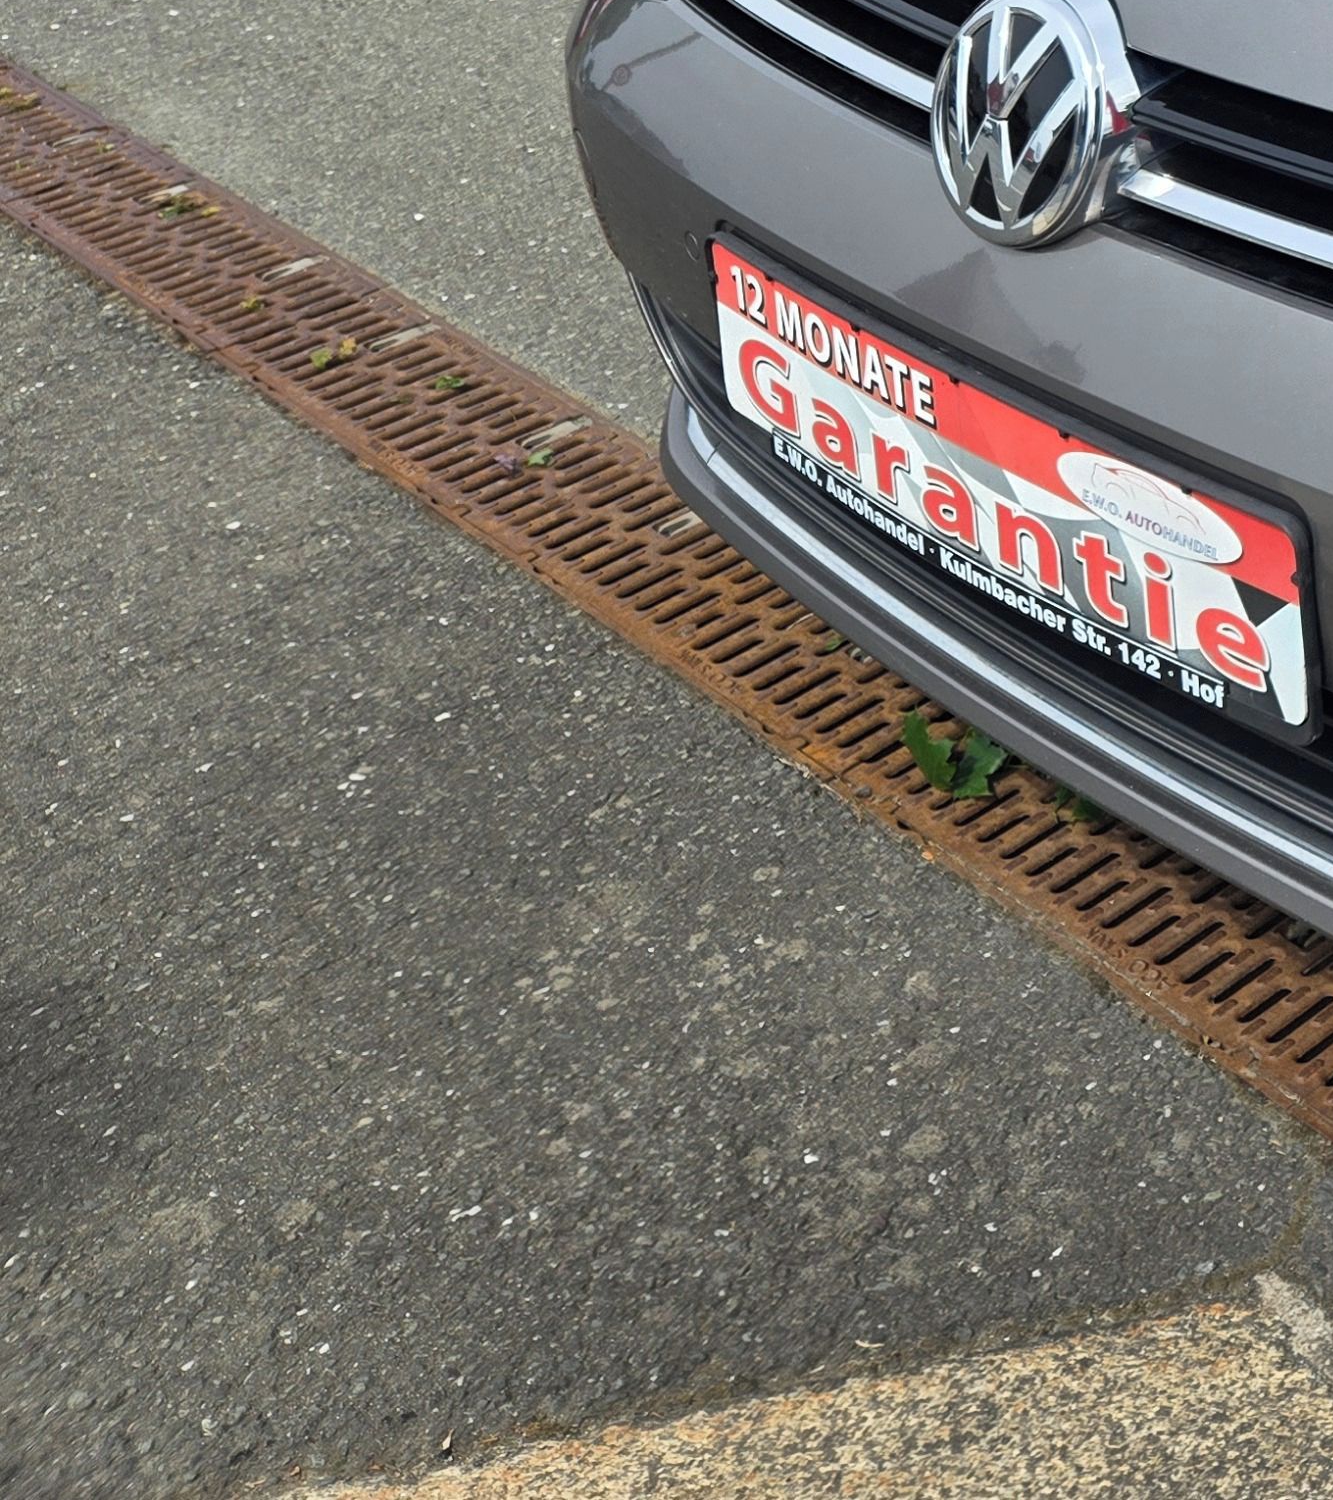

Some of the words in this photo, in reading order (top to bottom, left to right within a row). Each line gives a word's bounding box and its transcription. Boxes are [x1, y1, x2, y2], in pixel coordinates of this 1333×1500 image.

[730, 265, 767, 328] 12
[774, 290, 937, 430] MONATE
[738, 338, 1271, 693] Garantie
[773, 435, 823, 487] E.W.O.
[825, 473, 926, 556] Autohandel
[940, 545, 1067, 634] Kulmbacher
[1071, 617, 1112, 657] Str.
[1117, 642, 1162, 680] 142
[1179, 669, 1226, 709] Hof
[1081, 488, 1123, 520] E.W.O.
[1125, 510, 1219, 562] AUTOHANDEL
